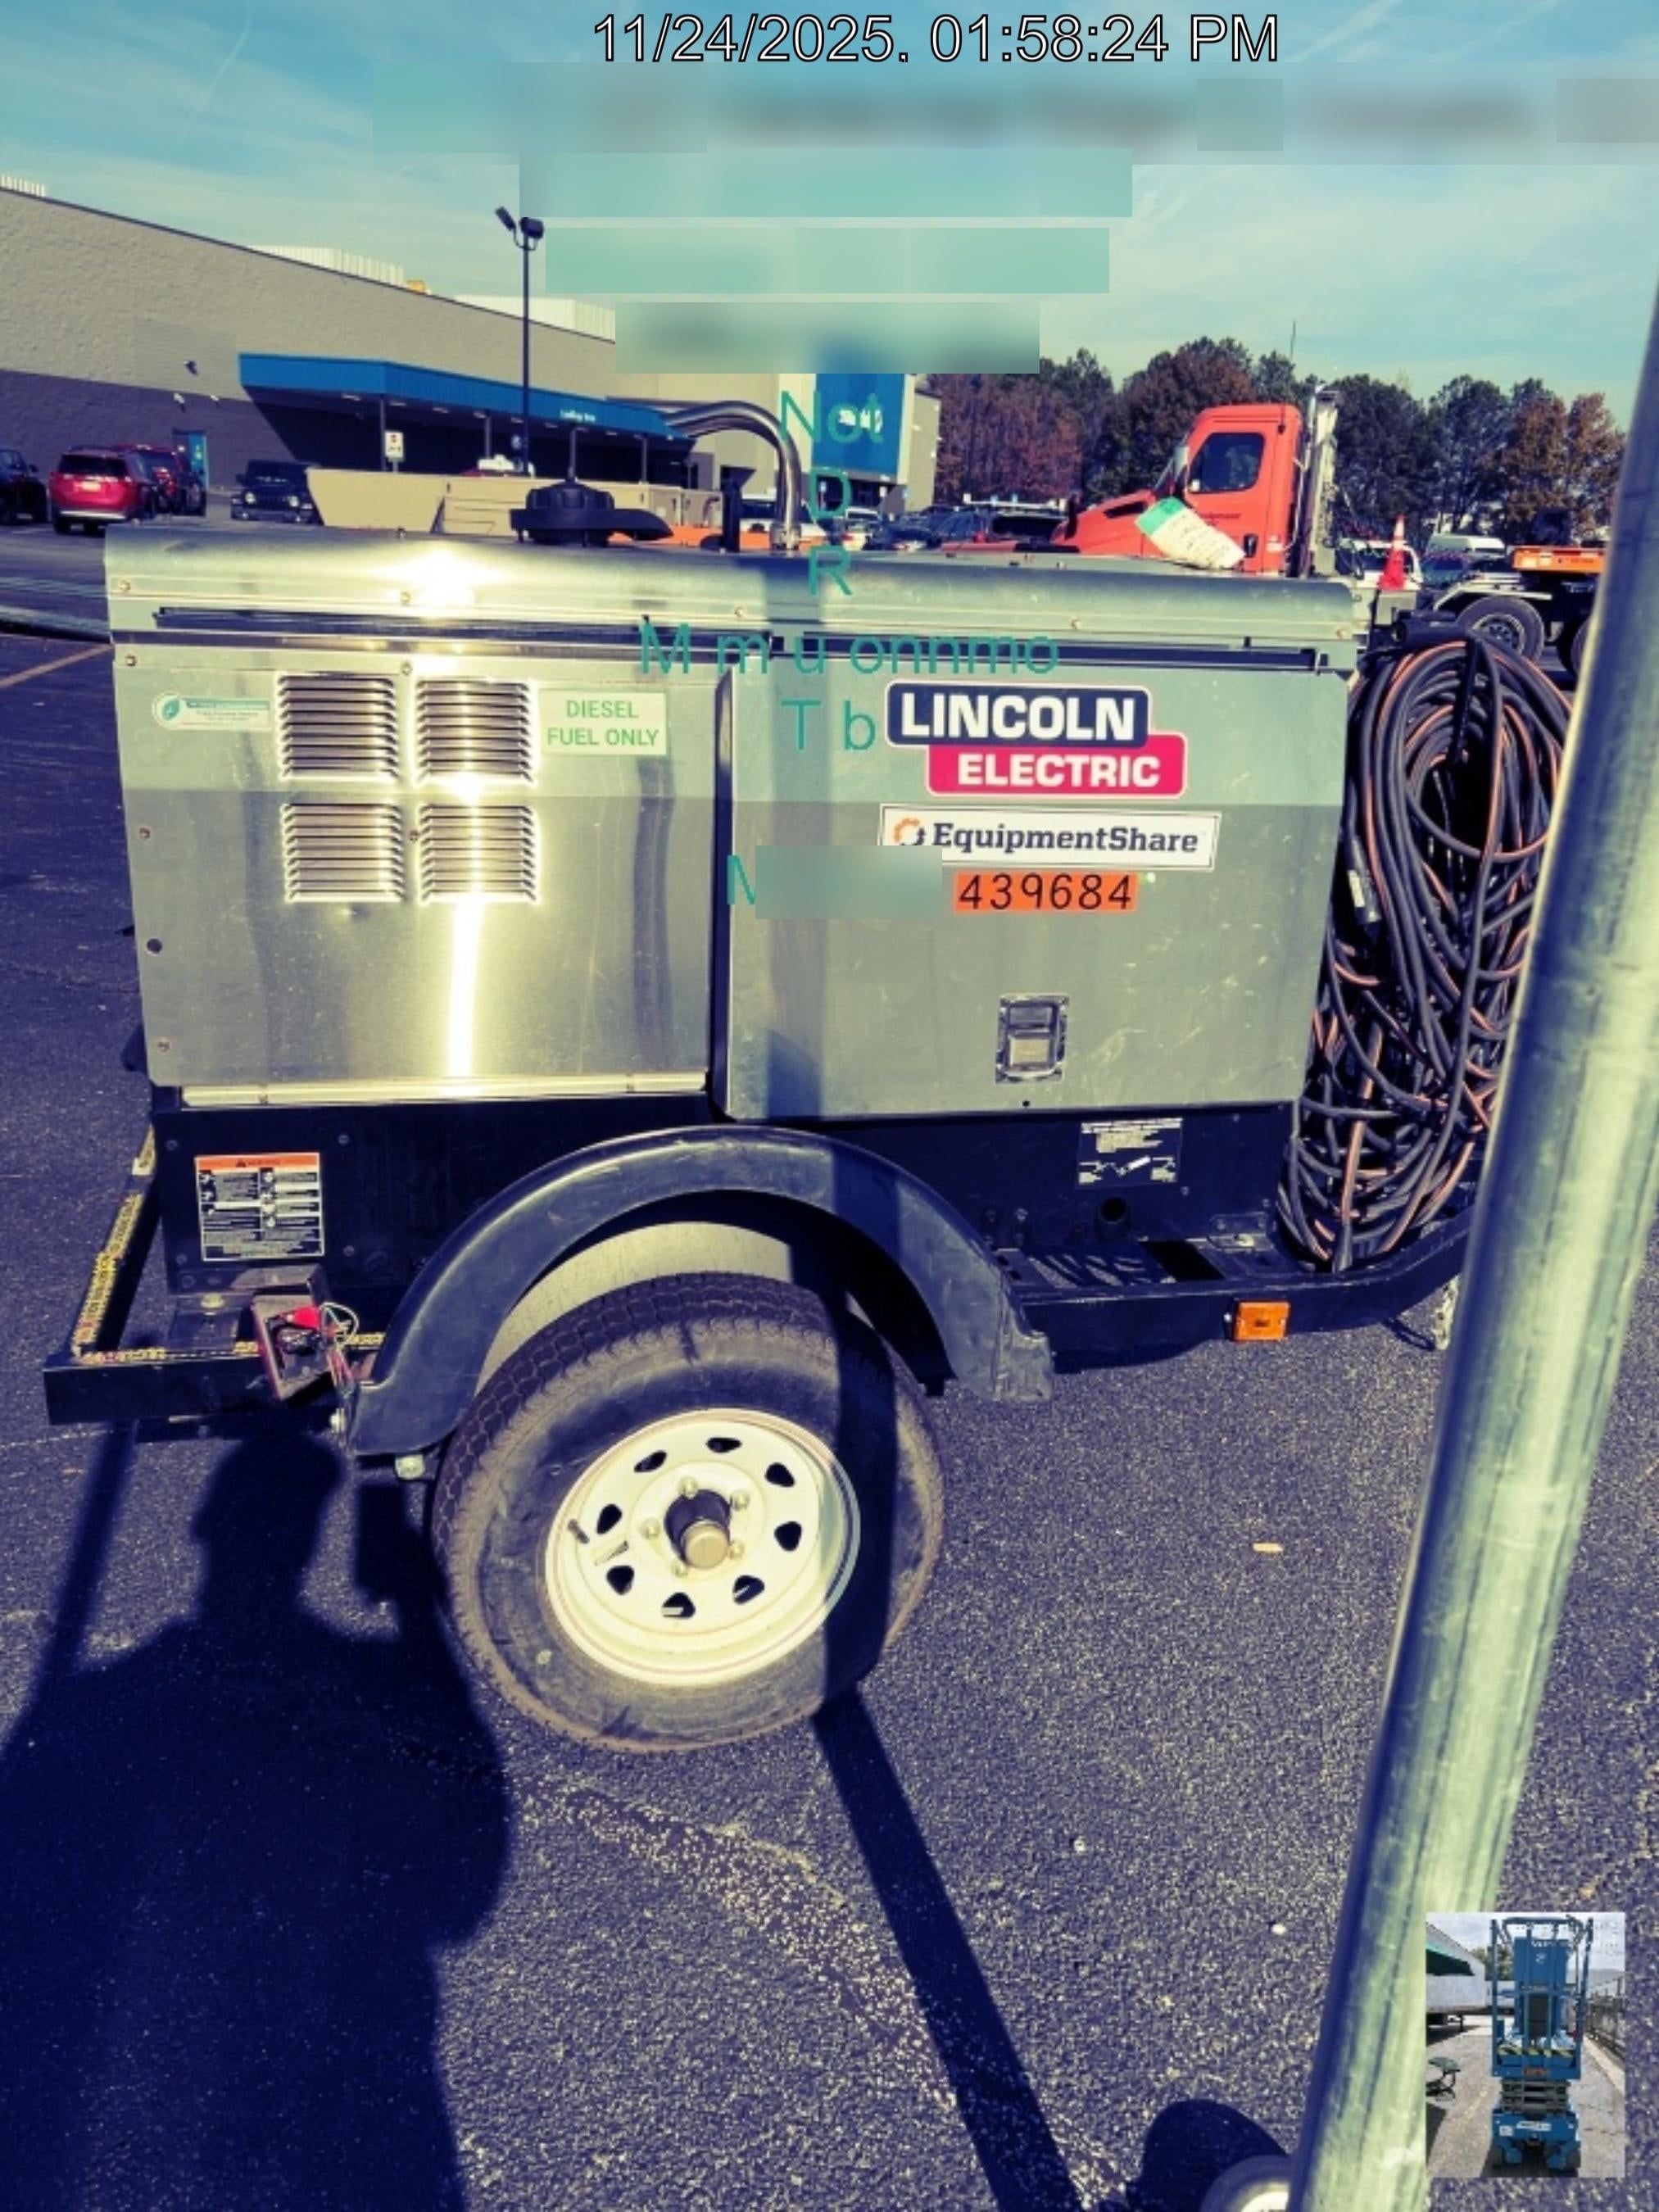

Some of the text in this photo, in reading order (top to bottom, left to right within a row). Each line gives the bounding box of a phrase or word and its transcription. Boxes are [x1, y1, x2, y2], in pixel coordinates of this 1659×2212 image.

[565, 700, 639, 718] DIESEL
[900, 691, 1135, 741] LINCOLN
[547, 727, 660, 746] FUEL ONLY
[957, 752, 1161, 788] ELECTRIC
[932, 822, 1199, 854] EquipmentShare
[958, 873, 1132, 911] 439684
